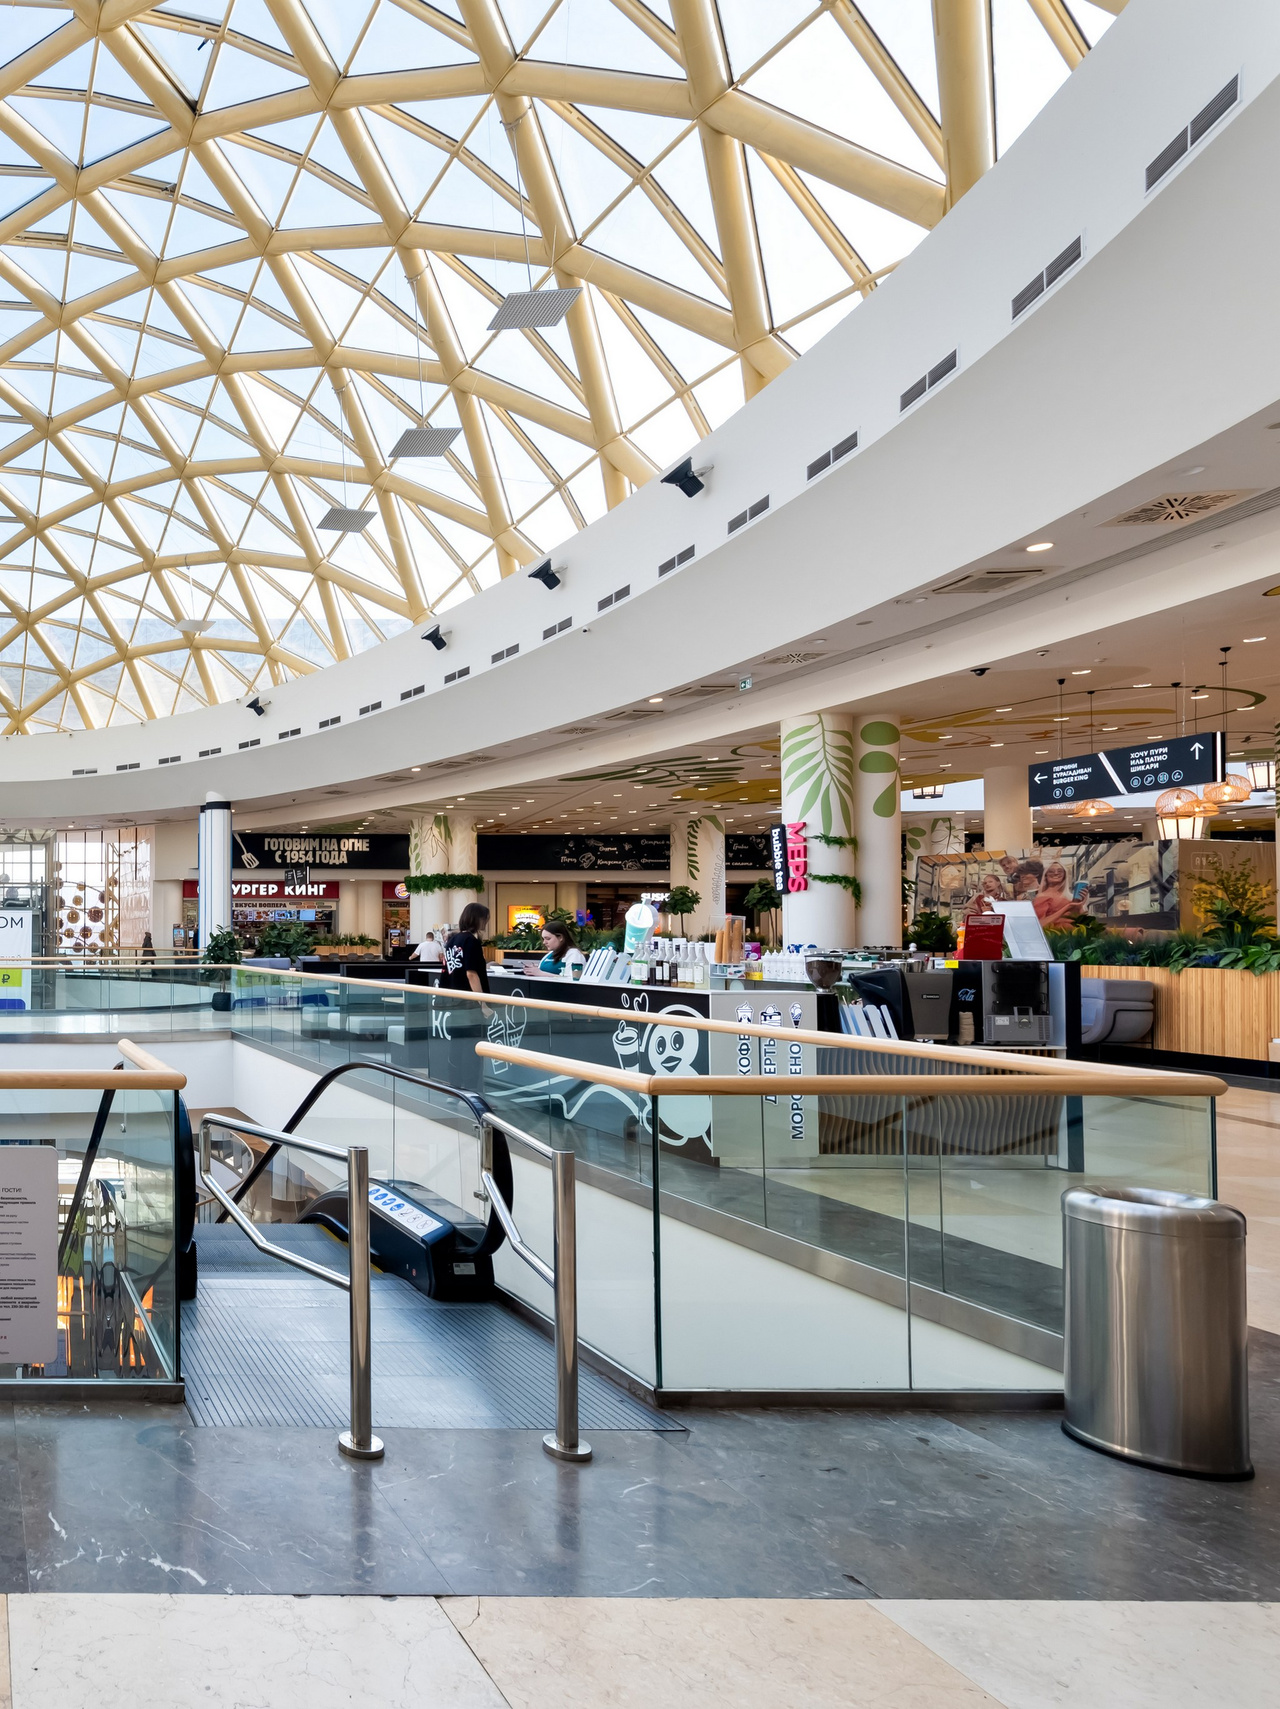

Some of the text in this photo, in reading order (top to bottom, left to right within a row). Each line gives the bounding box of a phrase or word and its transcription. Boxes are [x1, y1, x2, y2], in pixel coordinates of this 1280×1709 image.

[1130, 747, 1168, 759] ХОЧУ ПУРИ
[1145, 754, 1168, 763] ПАТИО
[1130, 763, 1159, 772] ШИКАРИ
[1053, 774, 1089, 785] BURGER KING
[264, 838, 370, 851] ГОТОВИМ НА ОГНЕ
[275, 851, 347, 865] С 1954 ГОДА
[772, 828, 784, 891] bubble tea
[787, 822, 808, 892] MEPS
[231, 884, 327, 896] УРГЕР КИНГ
